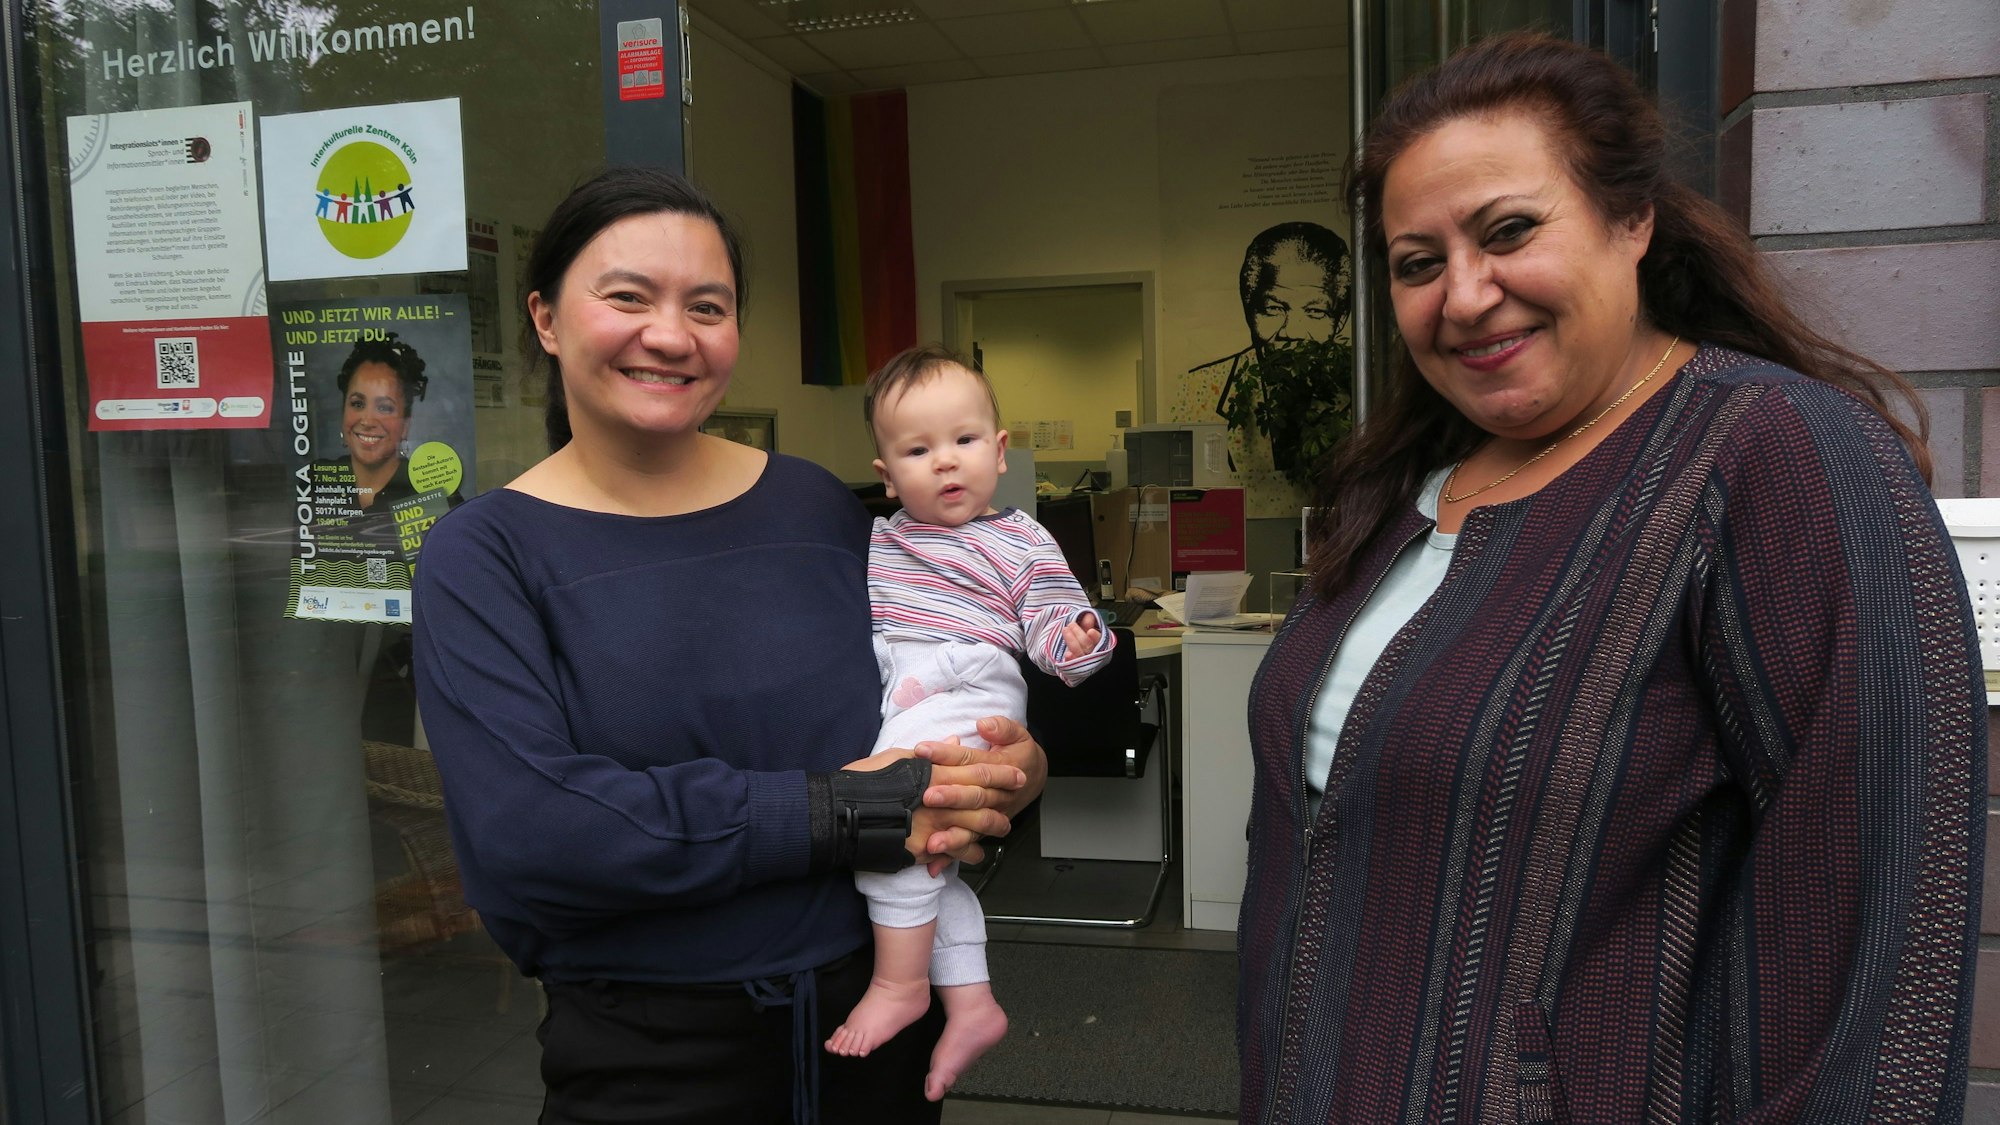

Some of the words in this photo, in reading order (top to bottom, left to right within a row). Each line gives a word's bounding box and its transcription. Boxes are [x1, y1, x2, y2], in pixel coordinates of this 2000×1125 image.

[102, 36, 235, 80] Herzlich
[248, 6, 475, 63] Willkommen!
[623, 38, 657, 47] verisure
[148, 149, 171, 157] Sprach-
[311, 125, 364, 168] Interkulturelle
[365, 124, 401, 146] Zentren
[400, 142, 418, 165] Köln
[282, 310, 315, 324] UND
[319, 308, 359, 323] JETZT
[362, 307, 392, 321] WIR
[396, 306, 439, 320] ALLE!
[286, 331, 318, 344] UND
[321, 329, 360, 344] JETZT
[364, 328, 390, 342] DU.
[288, 350, 310, 456] OGETTE
[314, 464, 337, 474] Lesung
[412, 456, 454, 472] Bestseller-Autorin
[322, 475, 338, 483] Nov.
[339, 475, 356, 483] 2023
[422, 468, 439, 476] kommt
[434, 476, 454, 486] Kerpen!
[314, 486, 346, 494] Jahnhalle
[347, 486, 372, 496] Kerpen
[314, 497, 347, 506] Jahnplatz
[392, 500, 416, 510] TUPOKA
[418, 492, 442, 503] OGETTE
[296, 464, 316, 574] TUPOKA
[316, 507, 336, 516] 50171
[394, 506, 424, 522] UND
[336, 518, 349, 526] Uhr
[400, 516, 437, 538] JETZT
[402, 536, 422, 551] DU
